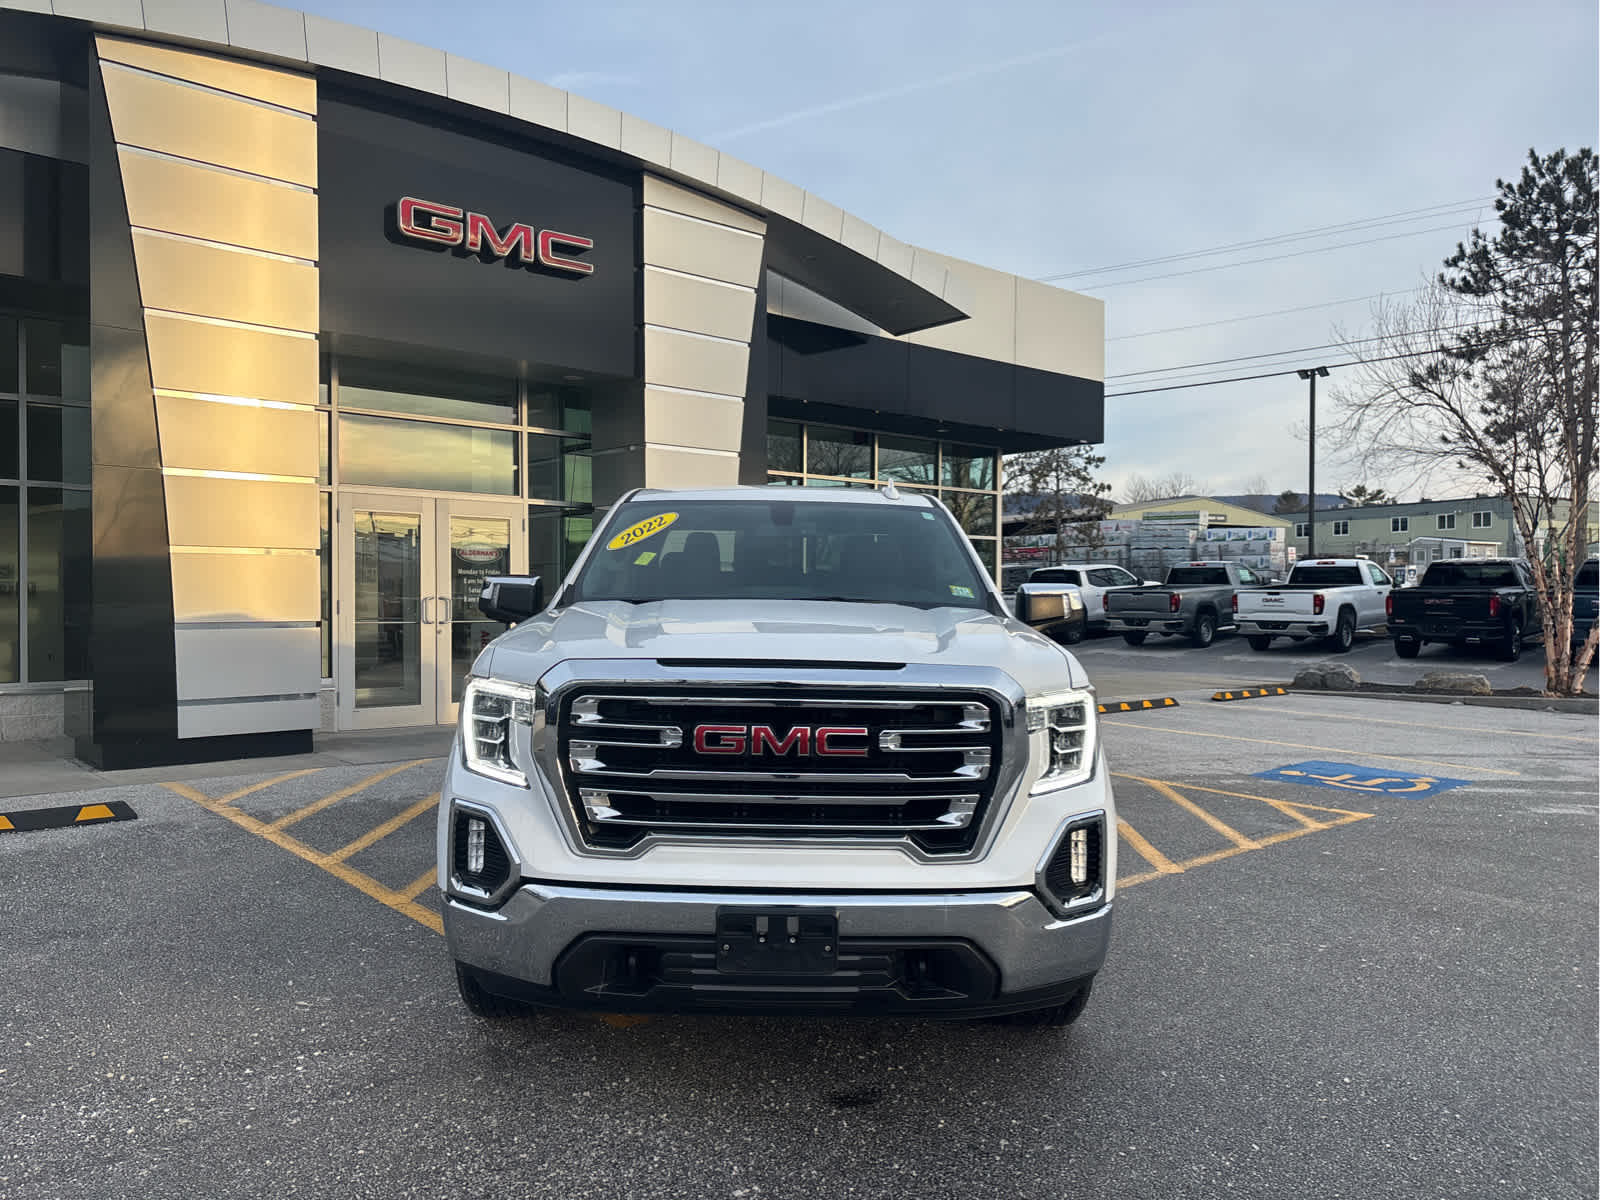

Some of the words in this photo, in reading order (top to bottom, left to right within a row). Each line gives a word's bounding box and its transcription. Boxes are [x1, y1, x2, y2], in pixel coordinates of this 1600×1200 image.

[398, 196, 594, 274] GMC
[621, 516, 667, 545] 2022
[694, 724, 868, 757] GMC
